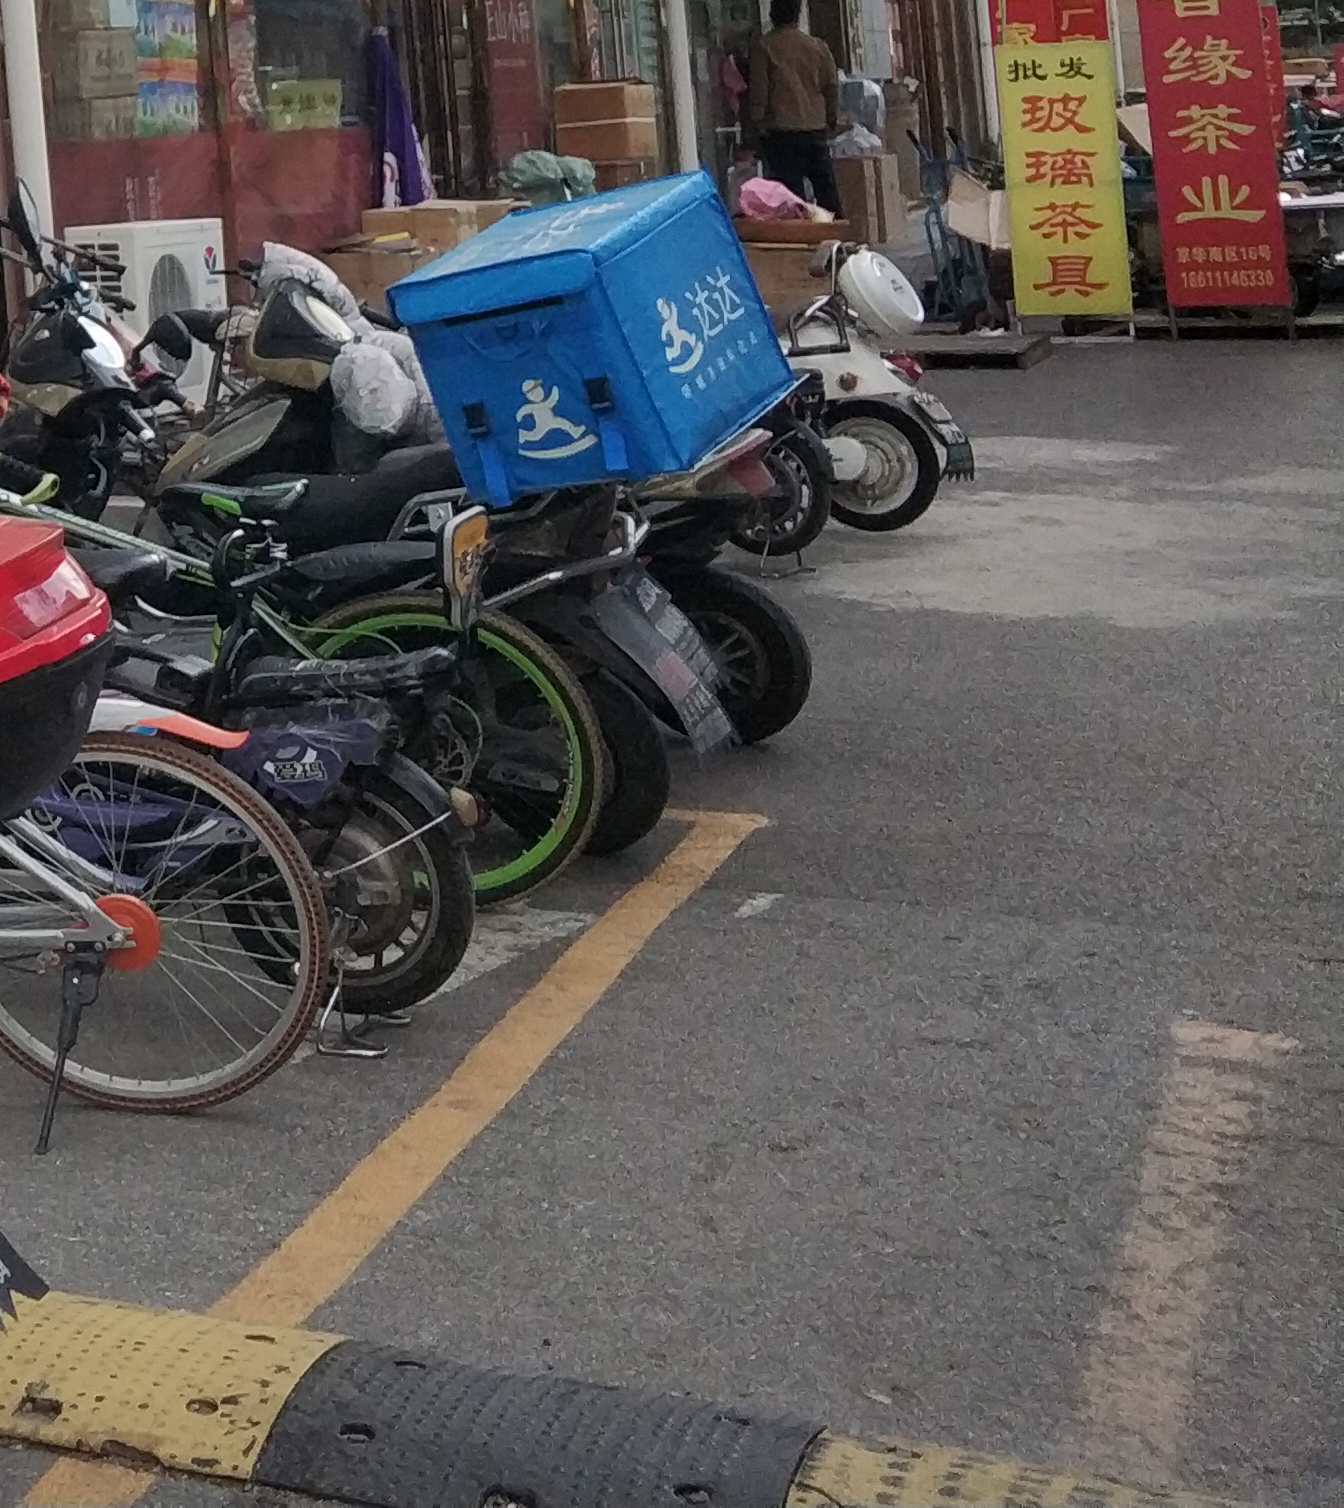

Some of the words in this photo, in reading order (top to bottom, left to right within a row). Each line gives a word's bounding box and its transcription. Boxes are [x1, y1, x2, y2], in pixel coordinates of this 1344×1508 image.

[1008, 56, 1095, 83] 批发
[1021, 93, 1110, 298] 玻璃茶具
[682, 265, 745, 338] 达达
